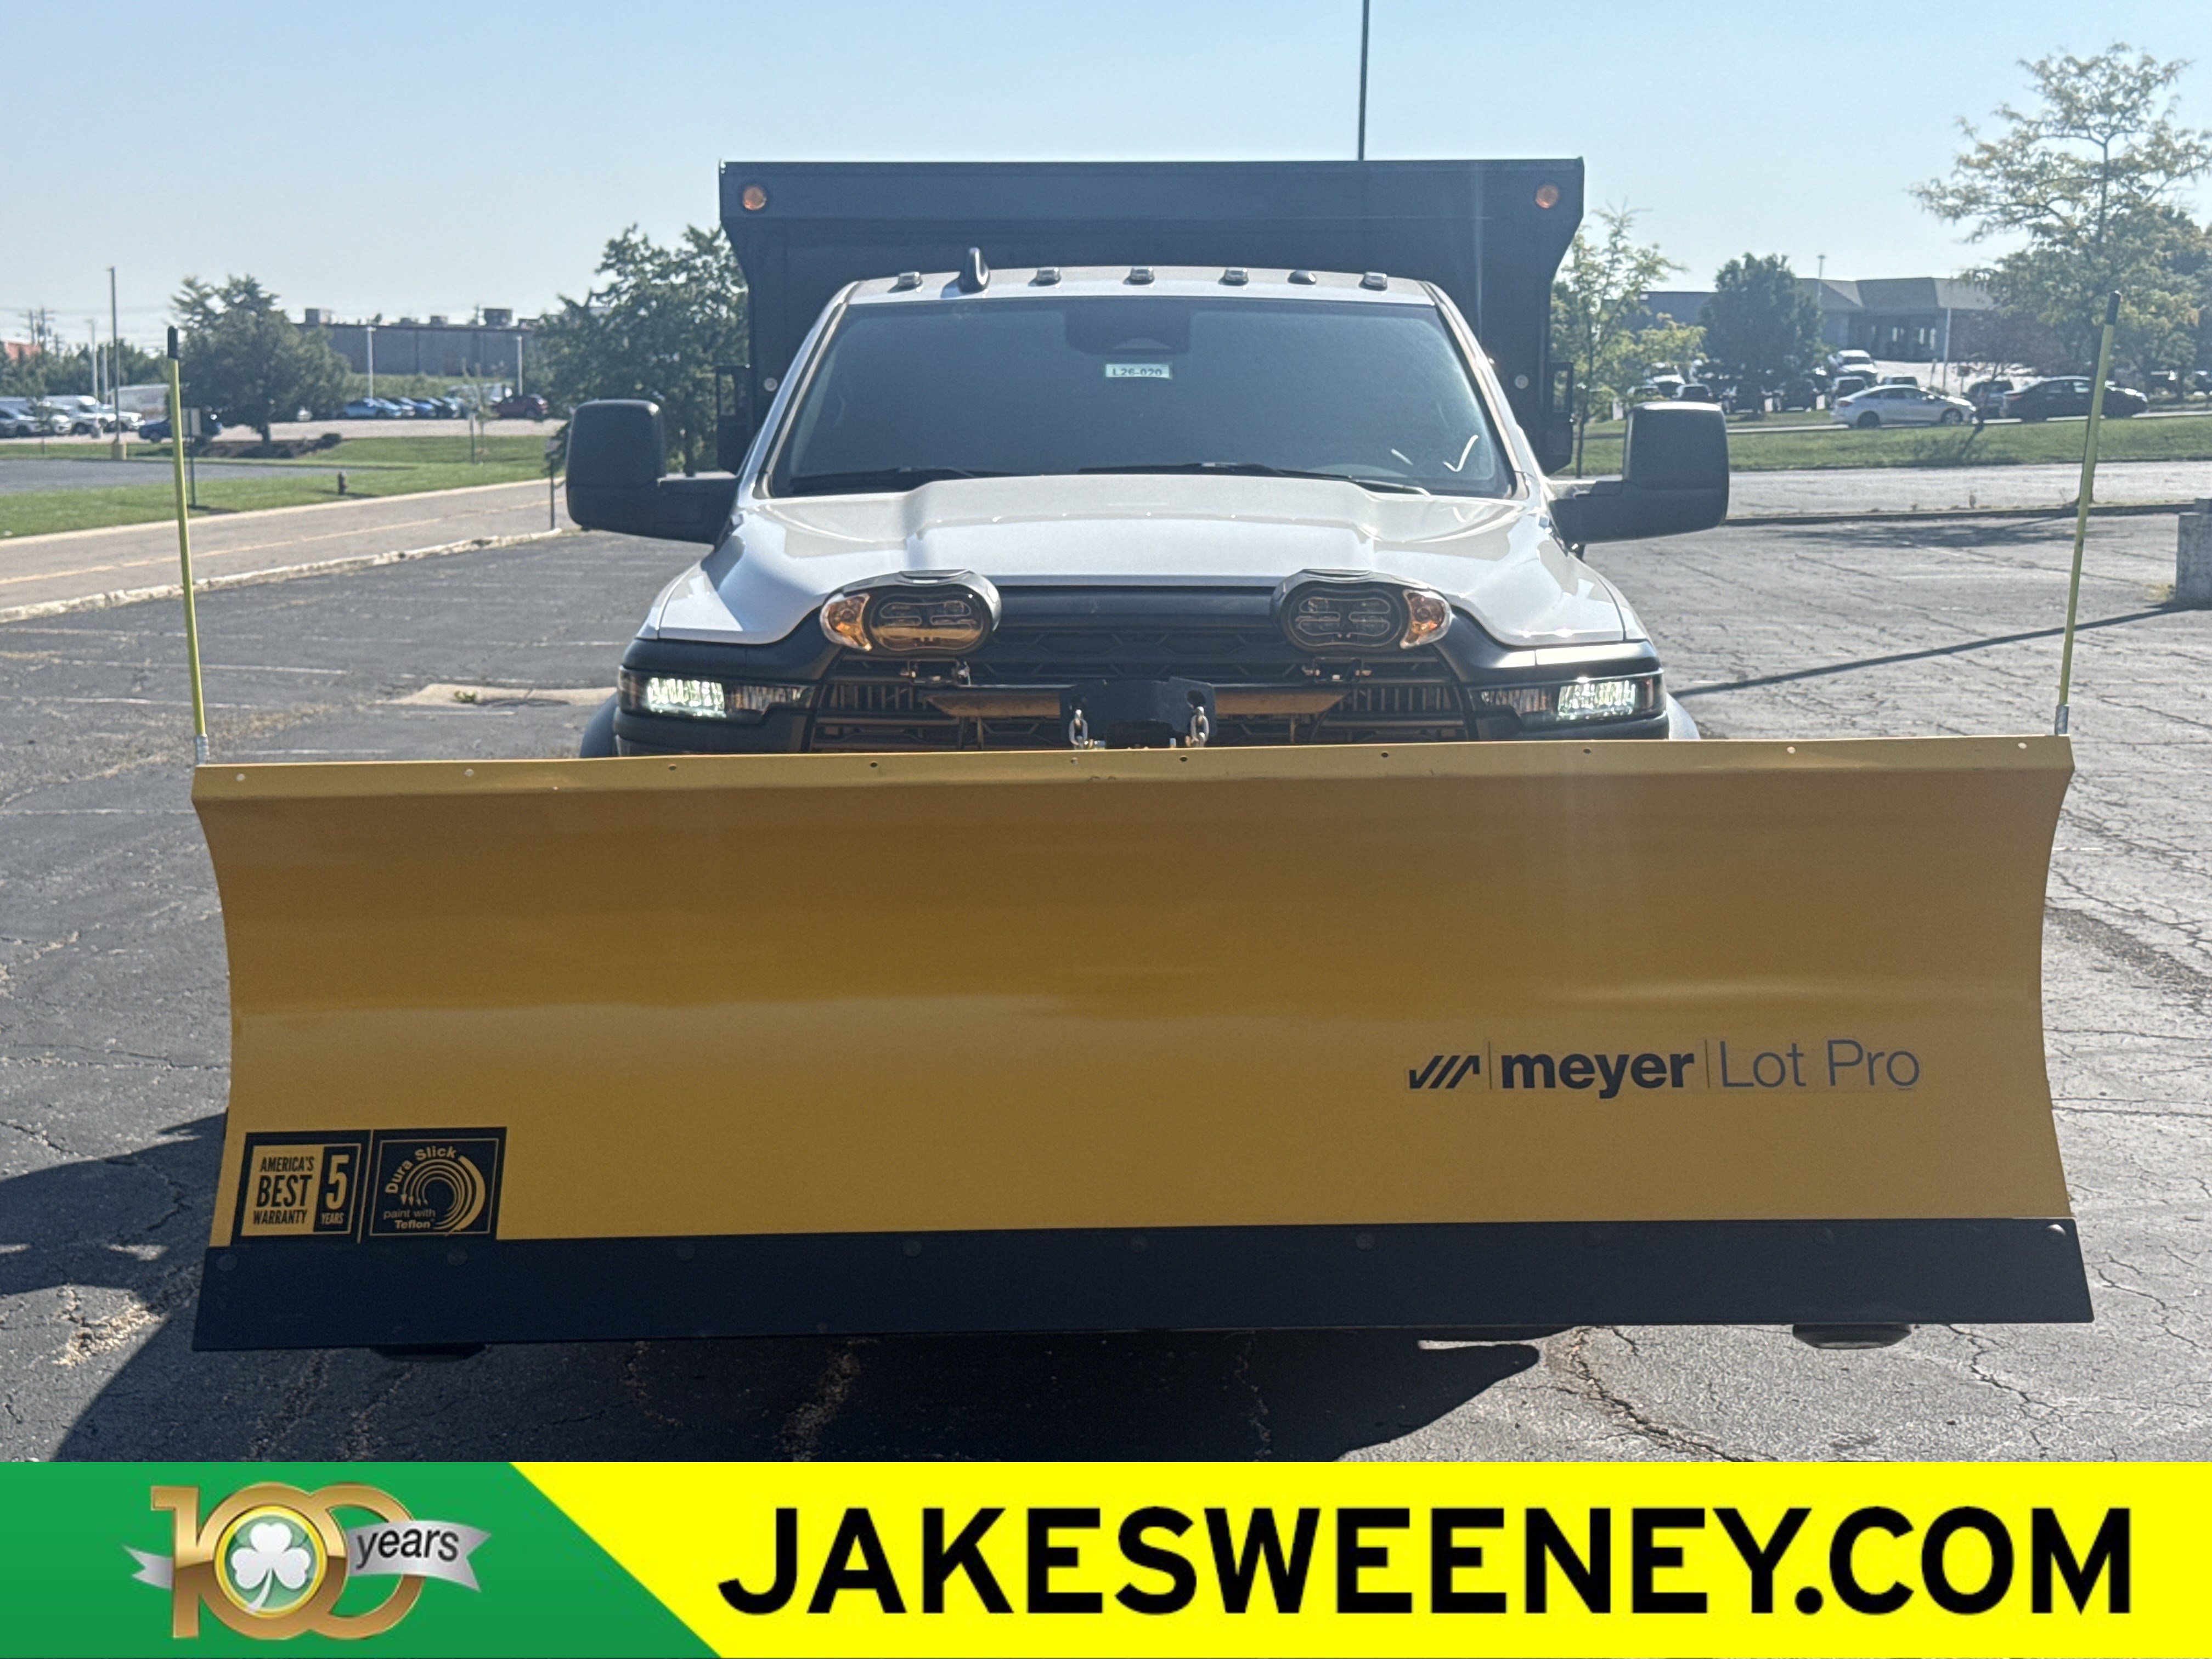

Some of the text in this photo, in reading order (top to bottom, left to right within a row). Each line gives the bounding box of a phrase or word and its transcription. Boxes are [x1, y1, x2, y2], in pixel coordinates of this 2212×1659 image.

[1502, 1040, 1920, 1099] meyer Lot Pro
[260, 1156, 314, 1172] AMERICA'S
[385, 1146, 456, 1194] Dura Slick
[256, 1174, 313, 1207] BEST
[326, 1154, 350, 1210] 5
[253, 1209, 308, 1225] WARRANTY
[321, 1212, 345, 1226] YEARS
[383, 1209, 436, 1220] paint with
